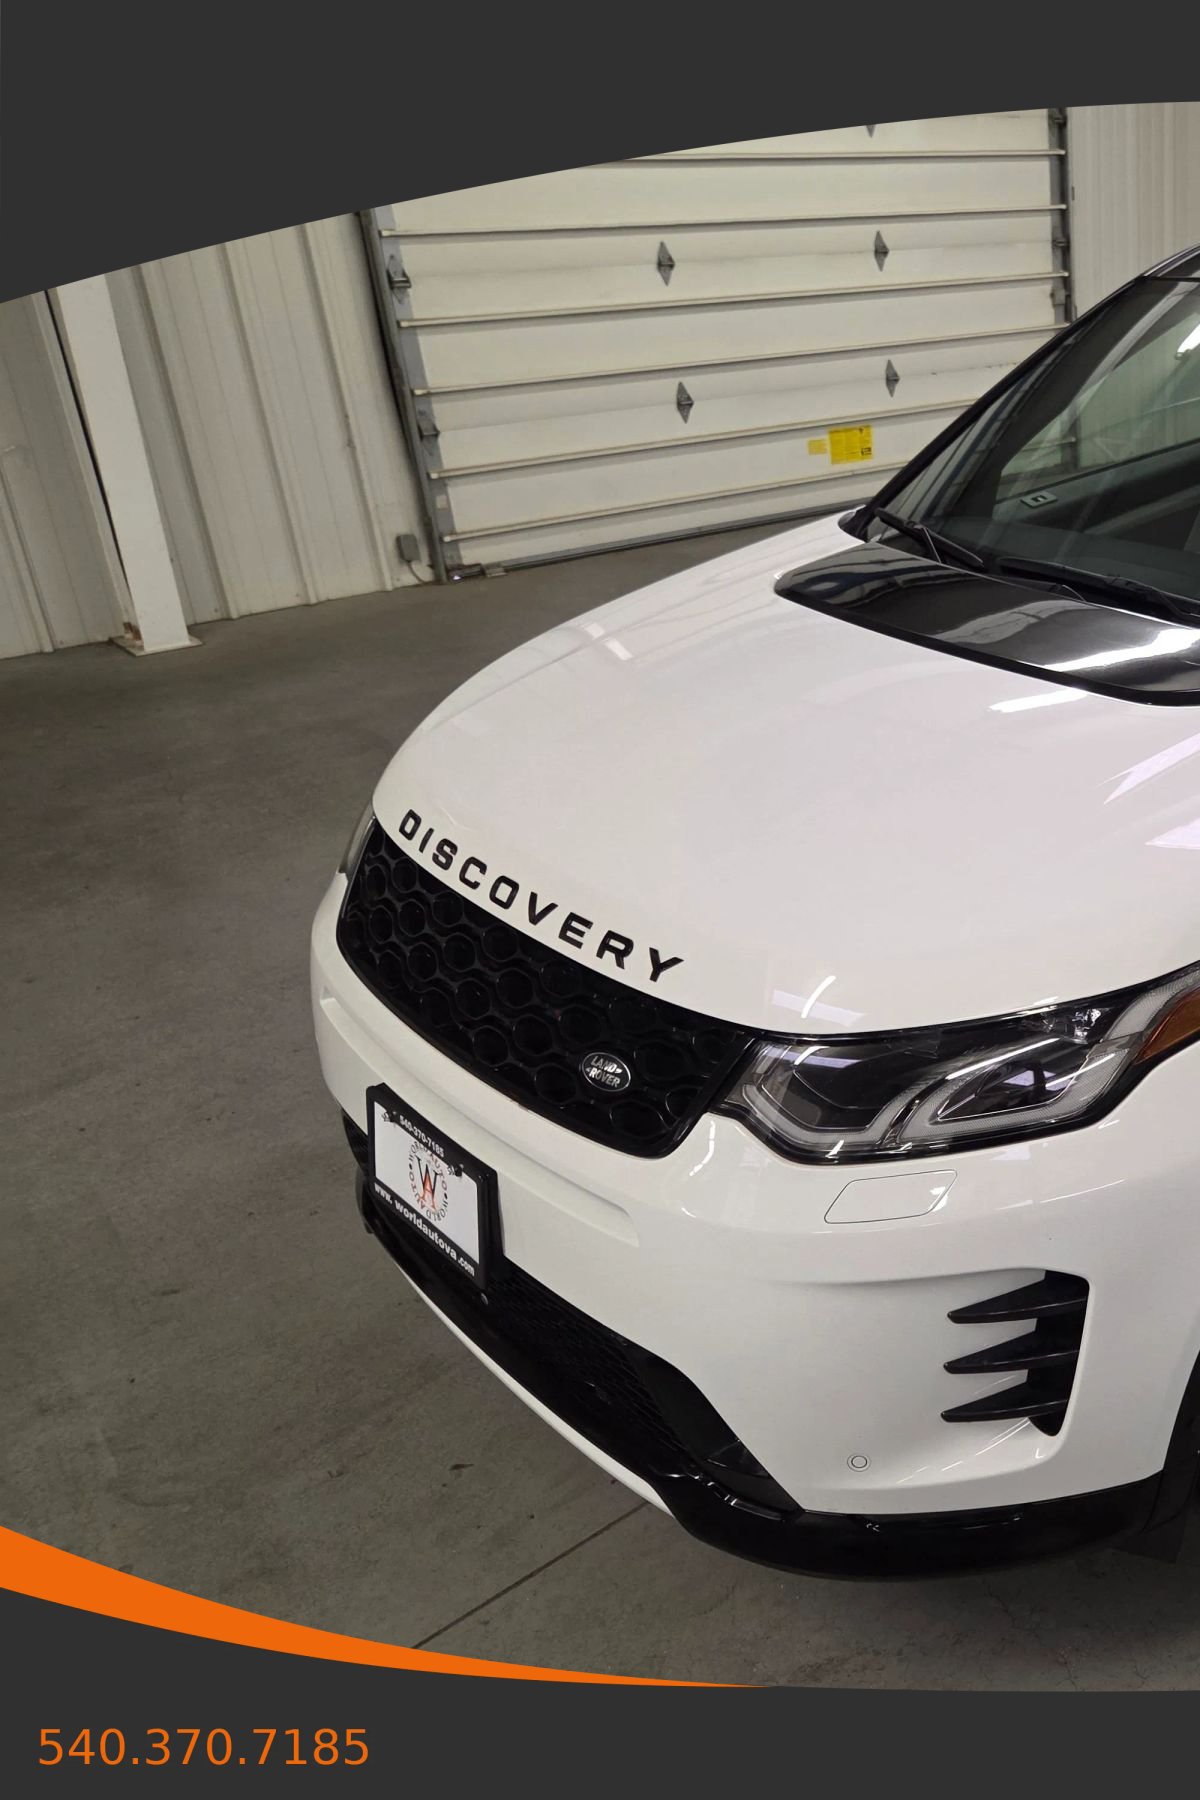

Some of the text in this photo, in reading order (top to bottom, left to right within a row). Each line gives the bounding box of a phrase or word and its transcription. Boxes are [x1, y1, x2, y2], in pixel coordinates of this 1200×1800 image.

[398, 808, 685, 983] DISCOVERY
[588, 1067, 621, 1088] ROVER
[590, 1055, 618, 1073] LAND
[399, 1114, 445, 1158] 540-370-7185
